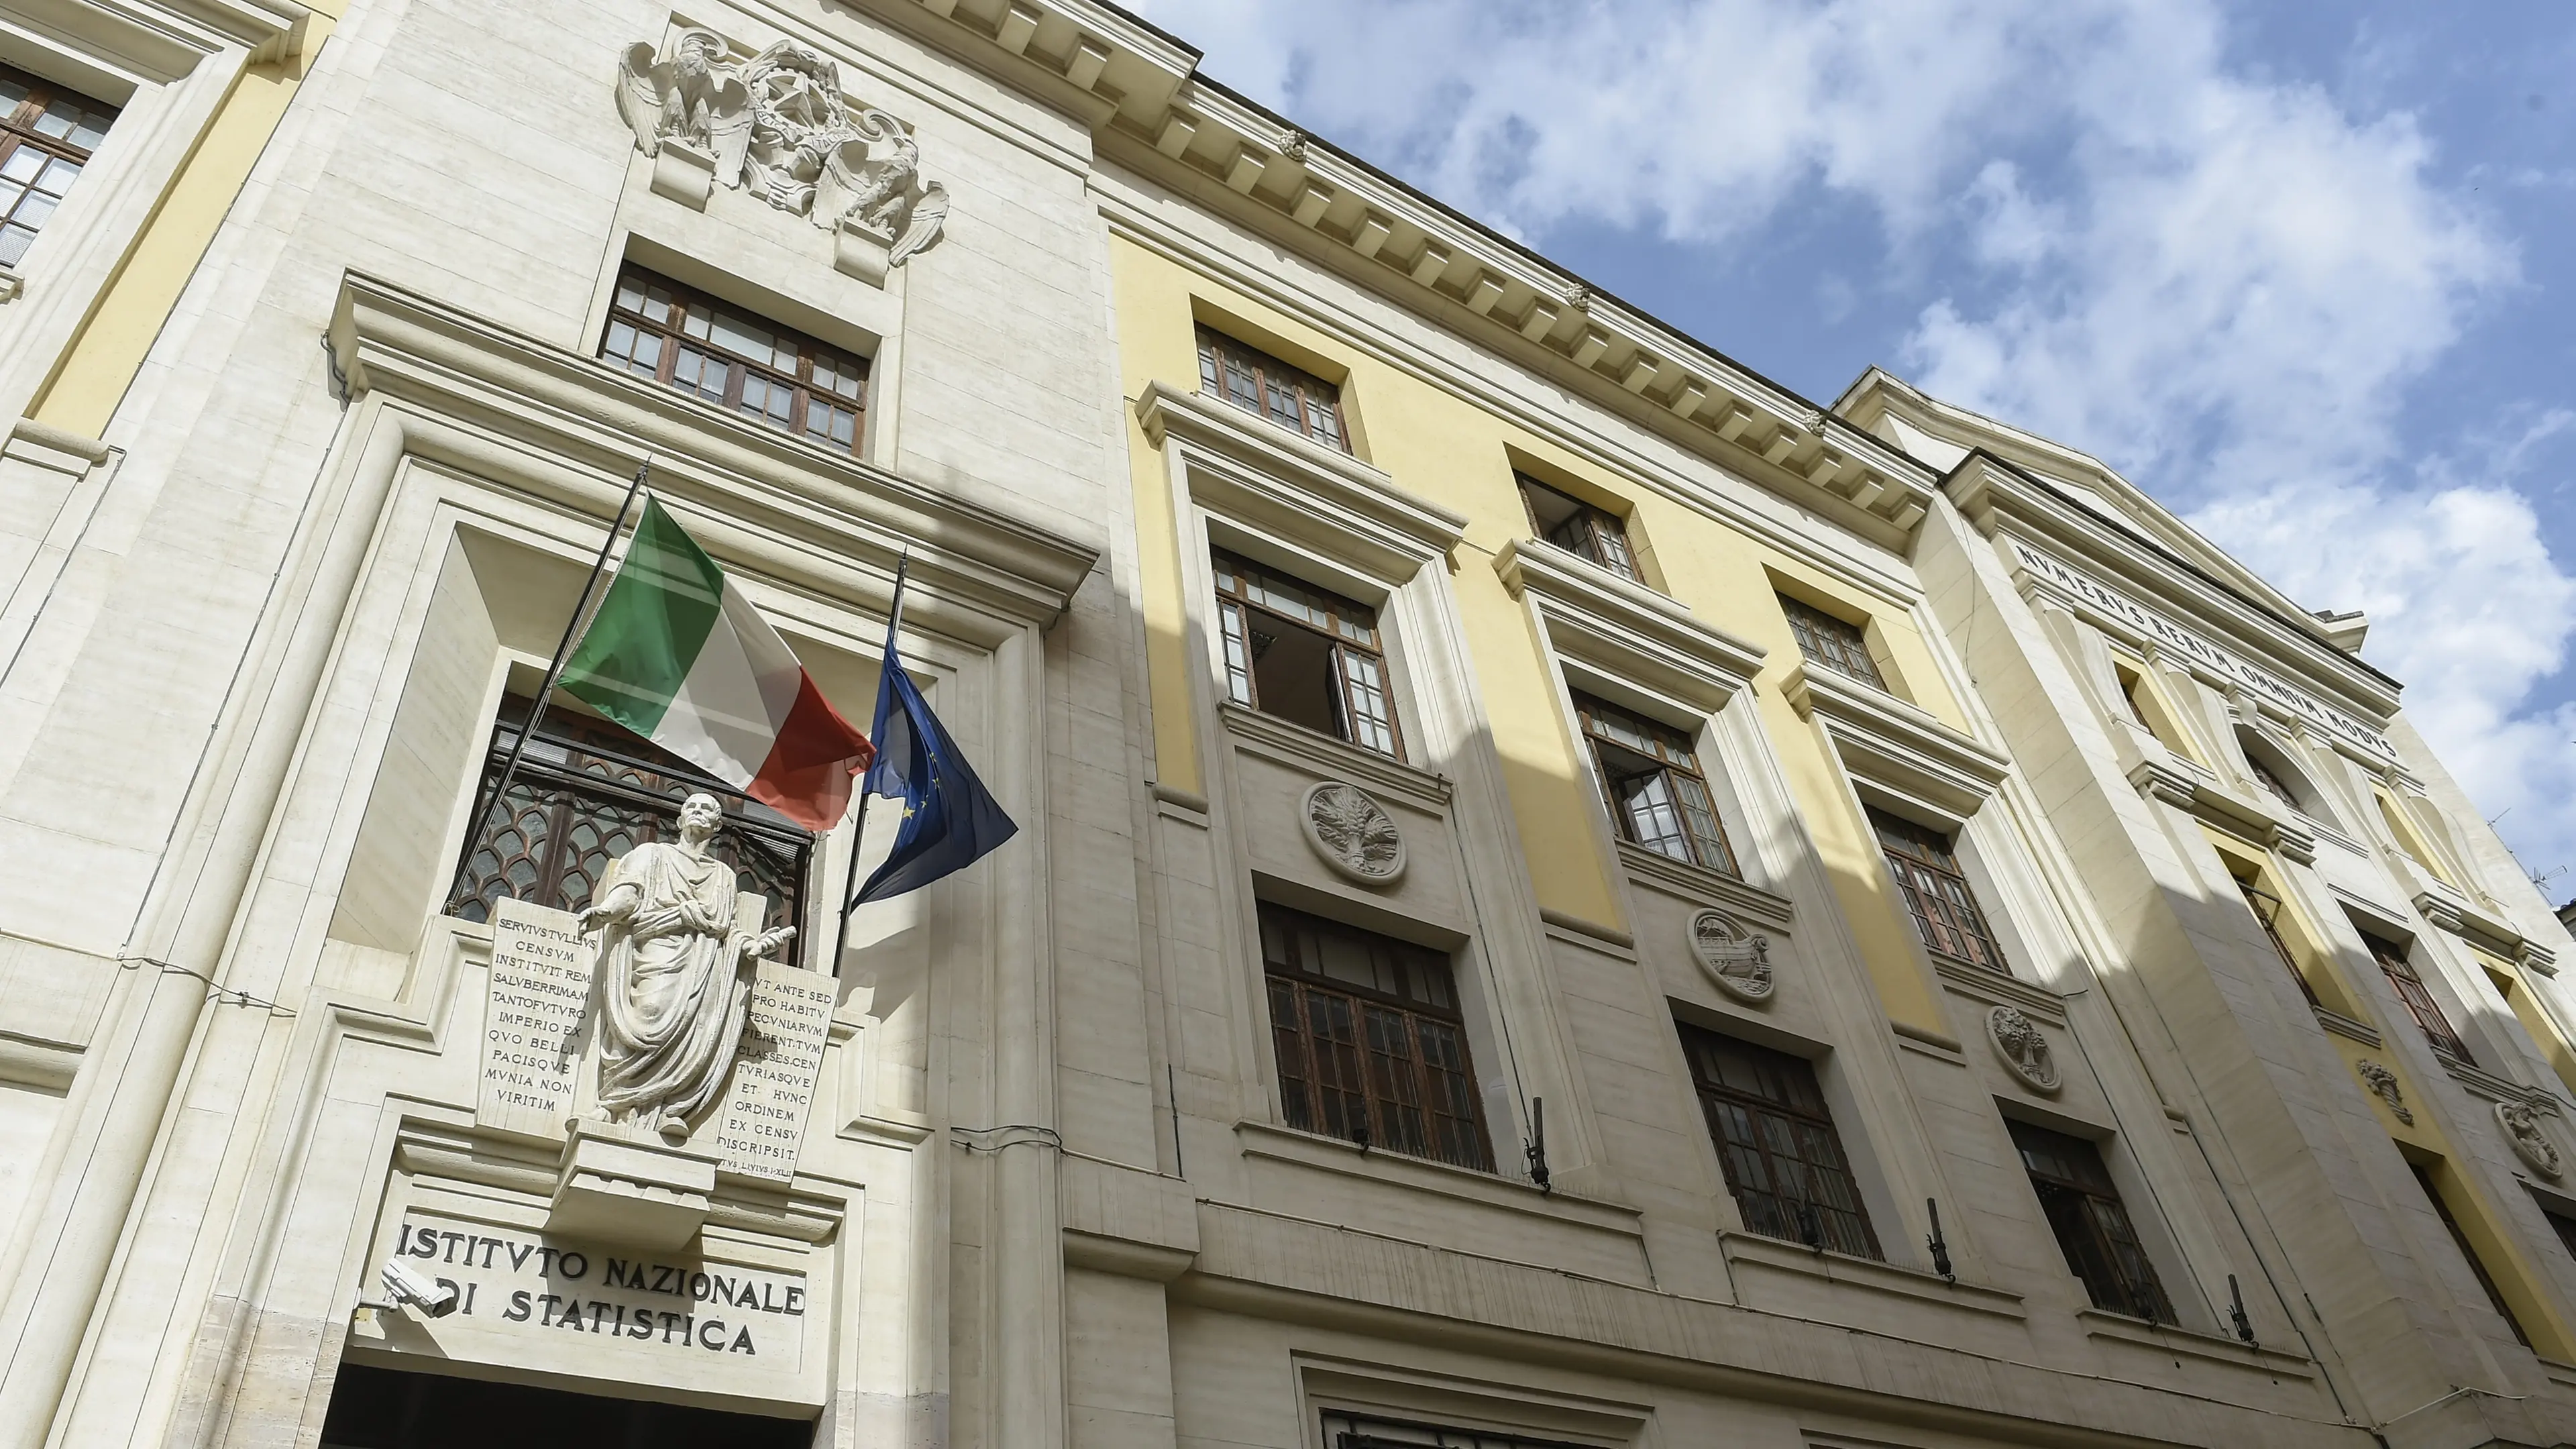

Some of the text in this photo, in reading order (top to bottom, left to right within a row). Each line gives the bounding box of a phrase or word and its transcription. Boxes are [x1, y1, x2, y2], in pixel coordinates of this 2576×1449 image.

[2015, 545, 2145, 625] NVMERVS
[2148, 615, 2235, 673] RERVM
[2324, 709, 2397, 757] NODVS
[515, 941, 575, 963] CENSVM
[495, 953, 591, 984] INSTITVIT REM
[493, 973, 589, 1002] SALVBERRIMAM
[755, 977, 833, 1004] VT ANTE SED
[752, 994, 826, 1019] PRO HABITV
[498, 1011, 582, 1037] IMPERIO EX
[747, 1010, 822, 1037] PECVNIARVM
[488, 1029, 575, 1055] QVO BELLI
[492, 1049, 570, 1075] PACISQVE
[484, 1068, 572, 1094] MVNIA NON
[738, 1063, 811, 1088] TVRIASQVE
[497, 1089, 555, 1112] VIRITIM
[741, 1083, 808, 1105] ET HVNC
[735, 1101, 795, 1122] ORDINEM
[729, 1118, 799, 1140] EX CENSV
[395, 1224, 805, 1316] ISTITVTO NAZIONALE
[502, 1289, 757, 1356] STATISTICA
